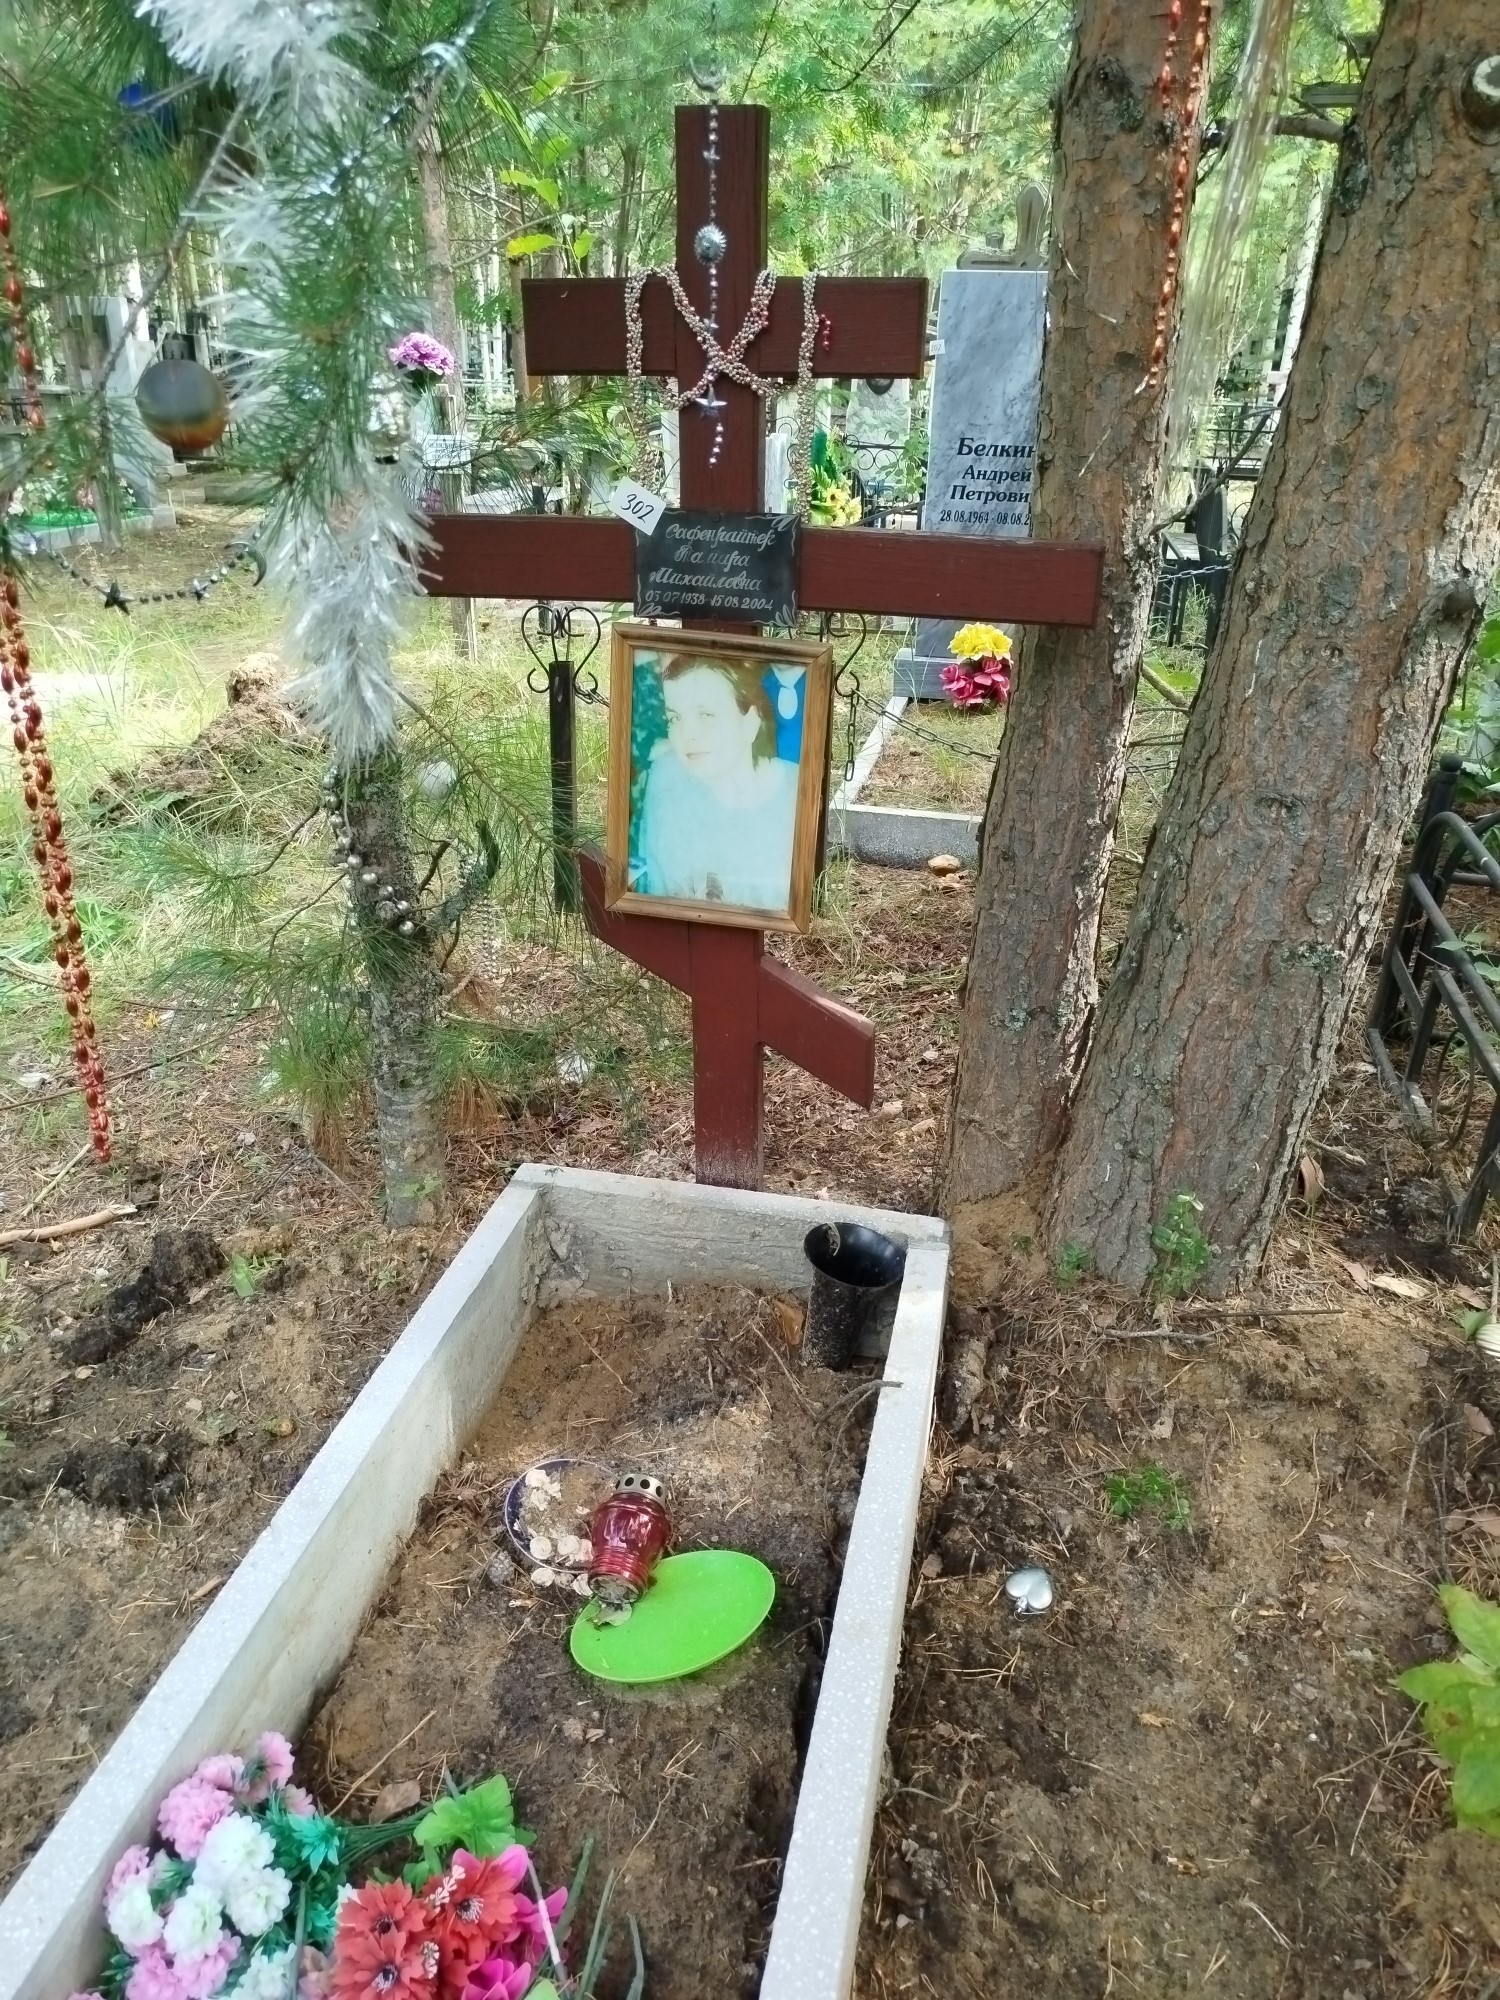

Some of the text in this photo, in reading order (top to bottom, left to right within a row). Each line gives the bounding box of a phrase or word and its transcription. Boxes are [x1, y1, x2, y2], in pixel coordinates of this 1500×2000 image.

[962, 464, 1033, 484] Андрей
[950, 484, 1030, 505] Петрови
[620, 493, 655, 524] 302
[940, 509, 989, 524] 28.08.1964
[996, 512, 1031, 526] 08.08.2
[649, 567, 762, 591] Михайловна
